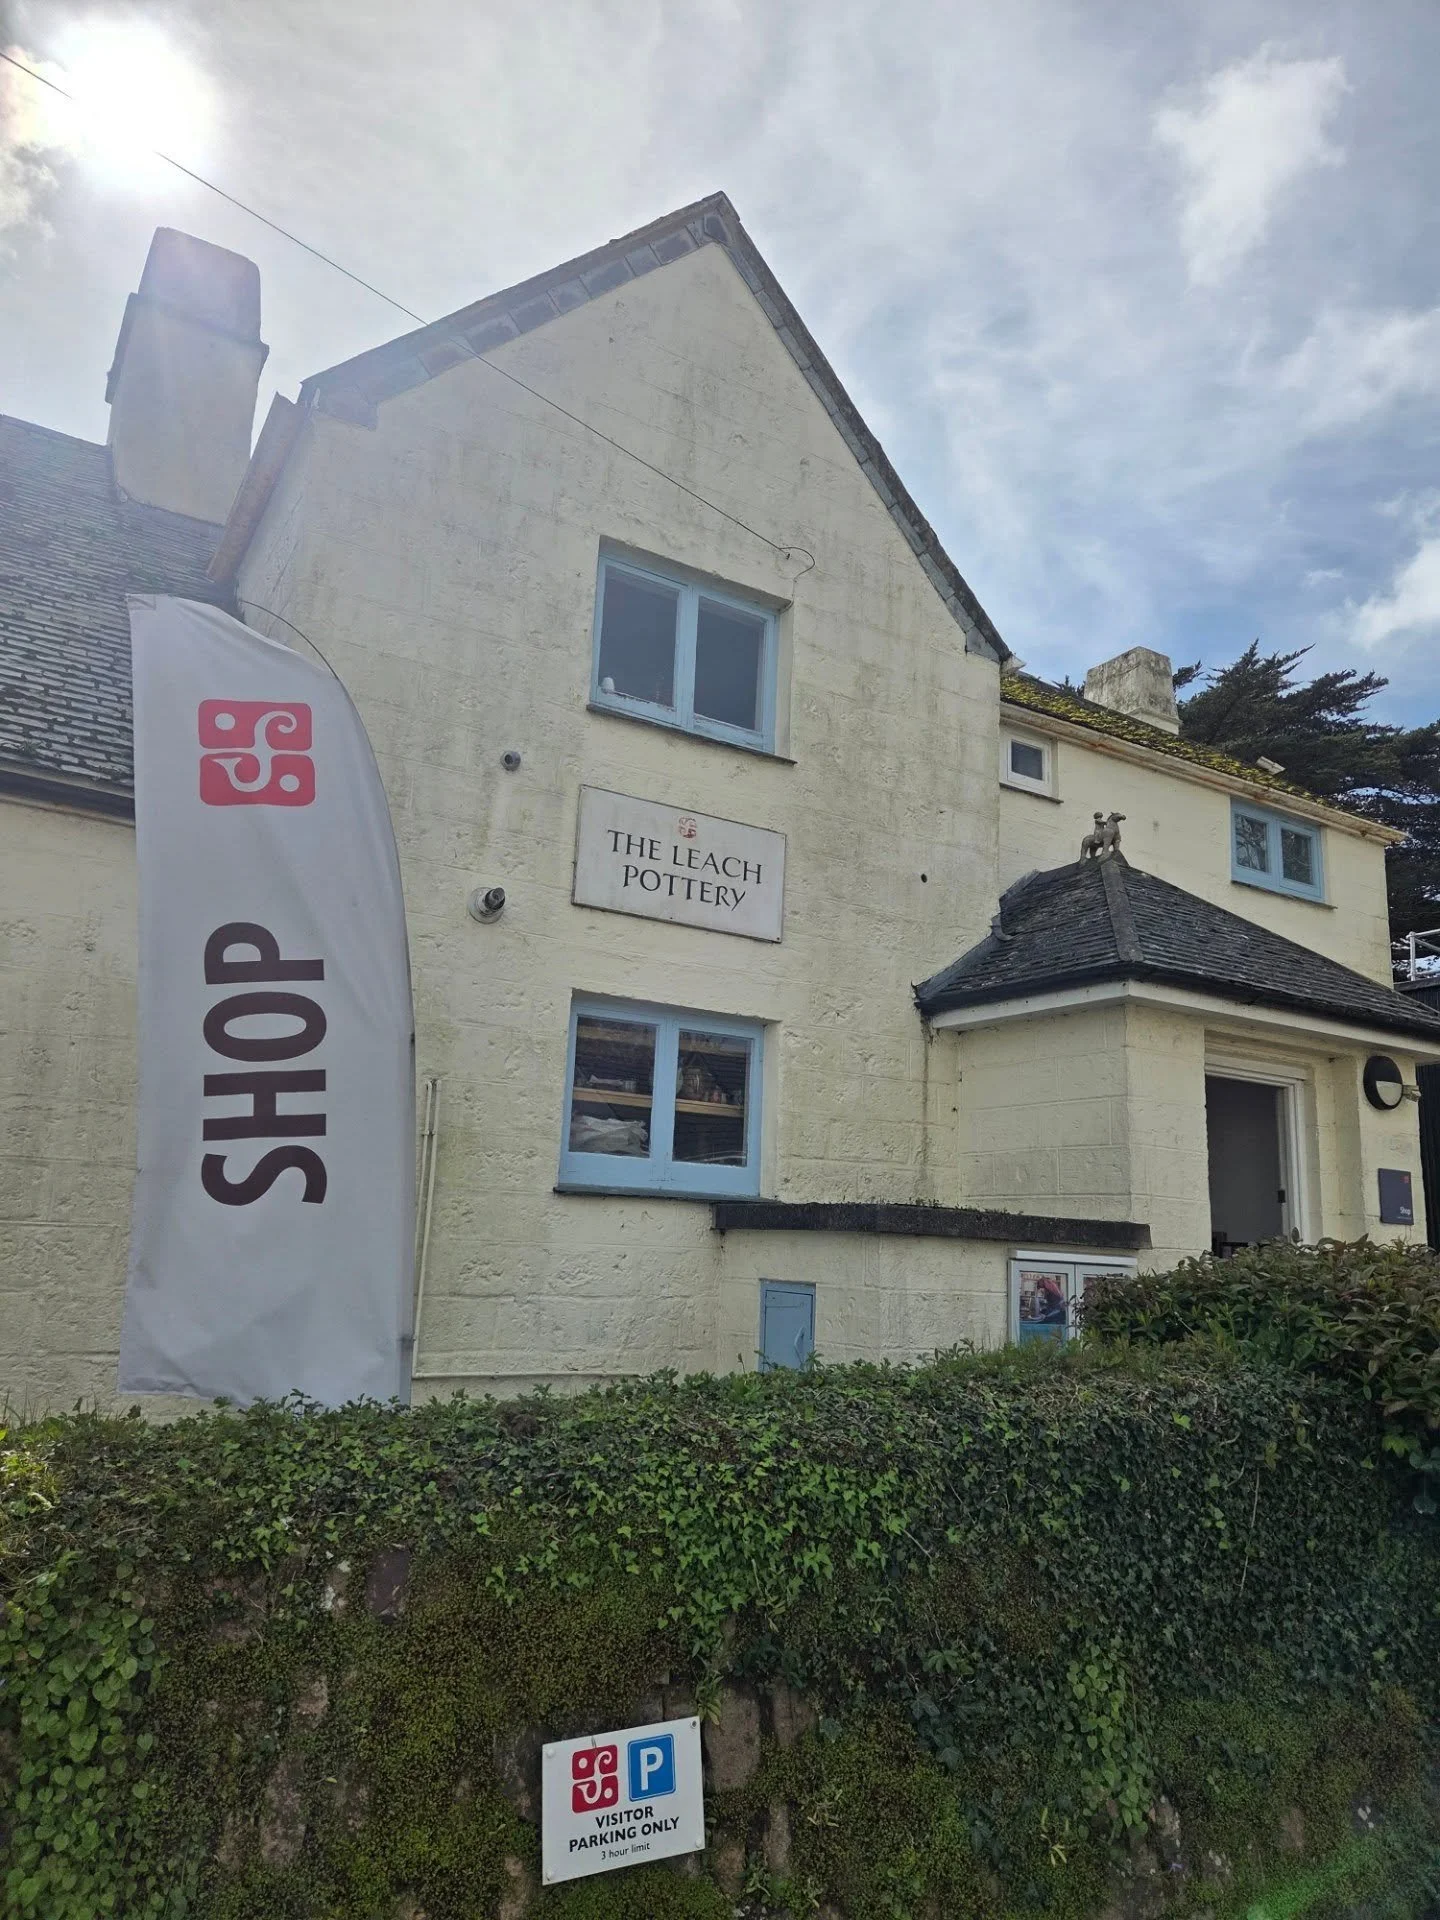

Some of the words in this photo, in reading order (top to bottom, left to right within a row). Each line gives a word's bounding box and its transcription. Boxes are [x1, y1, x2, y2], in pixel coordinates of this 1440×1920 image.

[607, 829, 662, 861] THE
[672, 845, 762, 884] LEACH
[622, 864, 746, 911] POTTERY
[201, 922, 328, 1206] SHOP
[639, 1746, 664, 1791] P
[569, 1826, 637, 1852] PARKING
[641, 1816, 680, 1836] ONLY
[595, 1806, 654, 1829] VISITOR
[601, 1850, 607, 1860] 3
[608, 1847, 629, 1858] hour
[631, 1842, 651, 1853] limit
